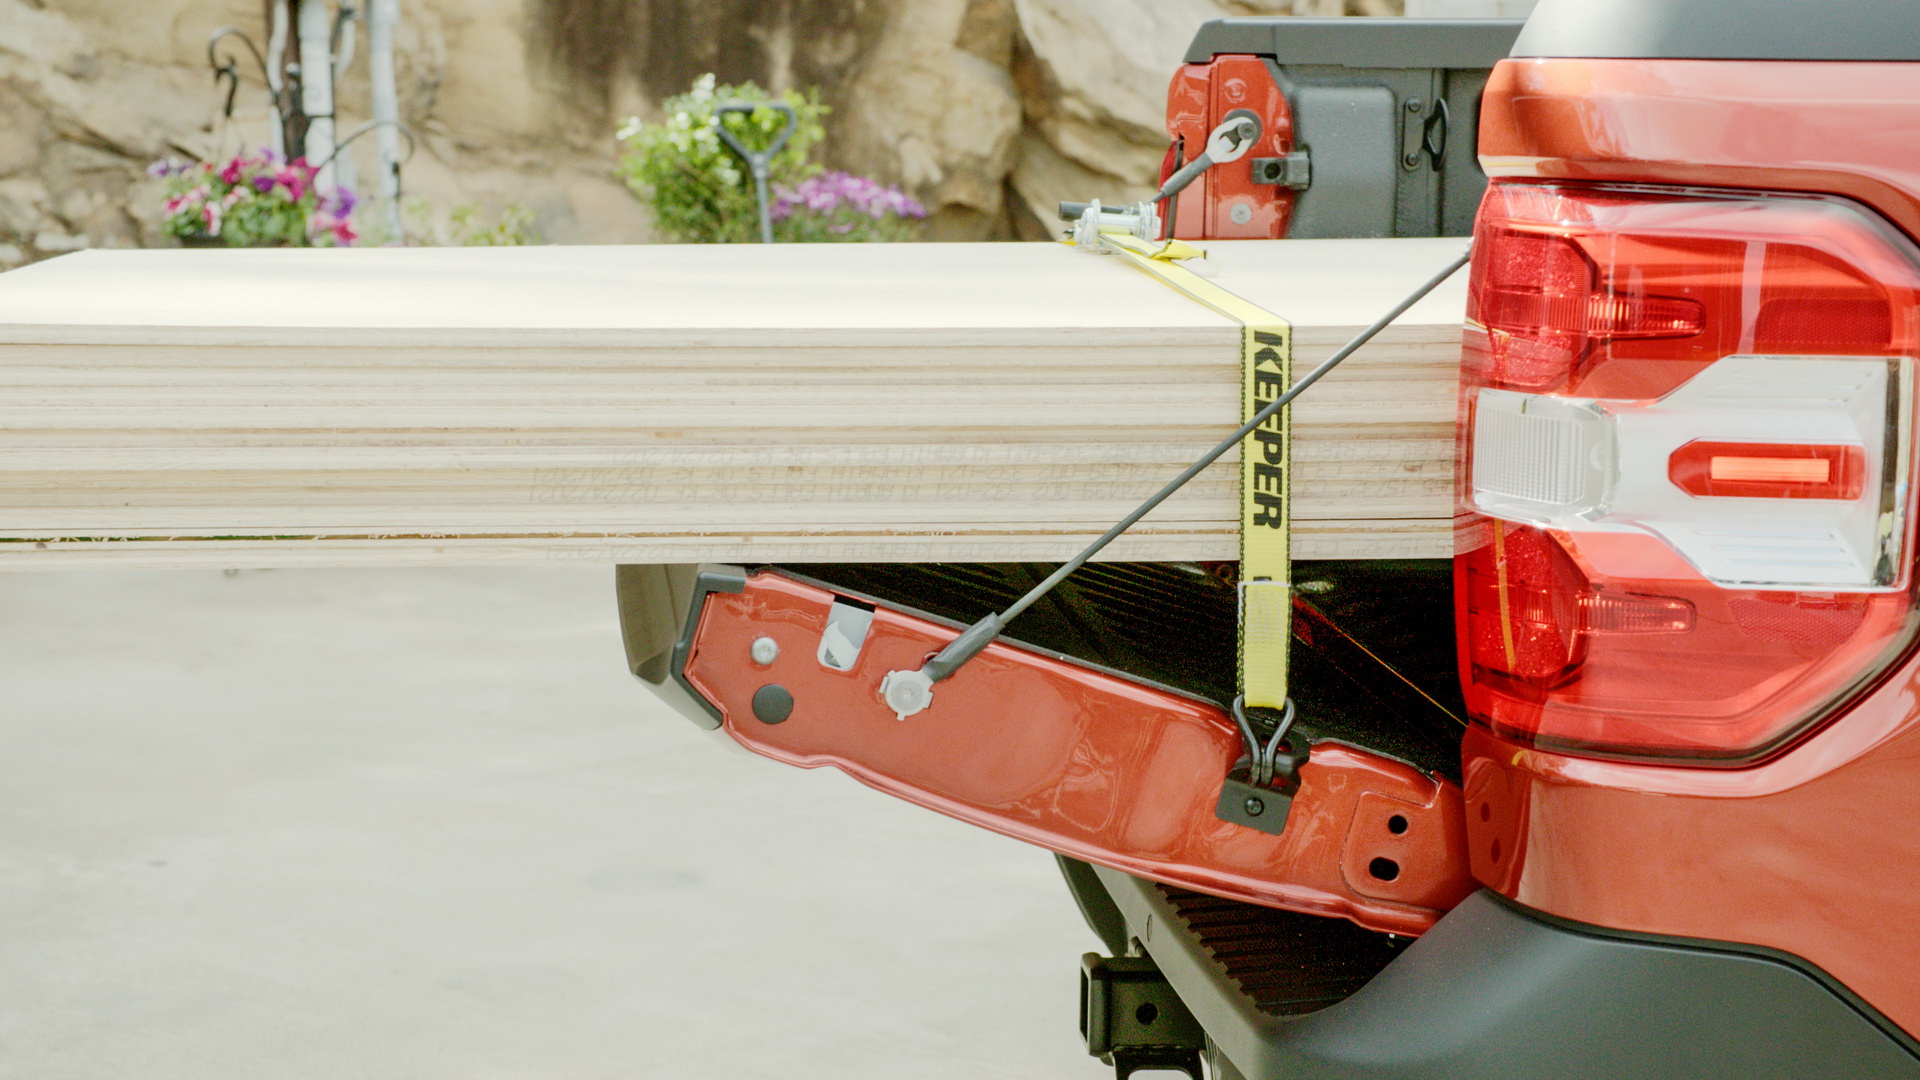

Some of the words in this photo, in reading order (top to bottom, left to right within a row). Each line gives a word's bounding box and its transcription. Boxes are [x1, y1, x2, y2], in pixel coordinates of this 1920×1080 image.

[1253, 330, 1284, 529] KEEPER
[749, 466, 816, 483] FALLS
[831, 465, 924, 482] KLAMATH
[750, 485, 816, 502] FALLS
[829, 484, 920, 502] KLAMATH
